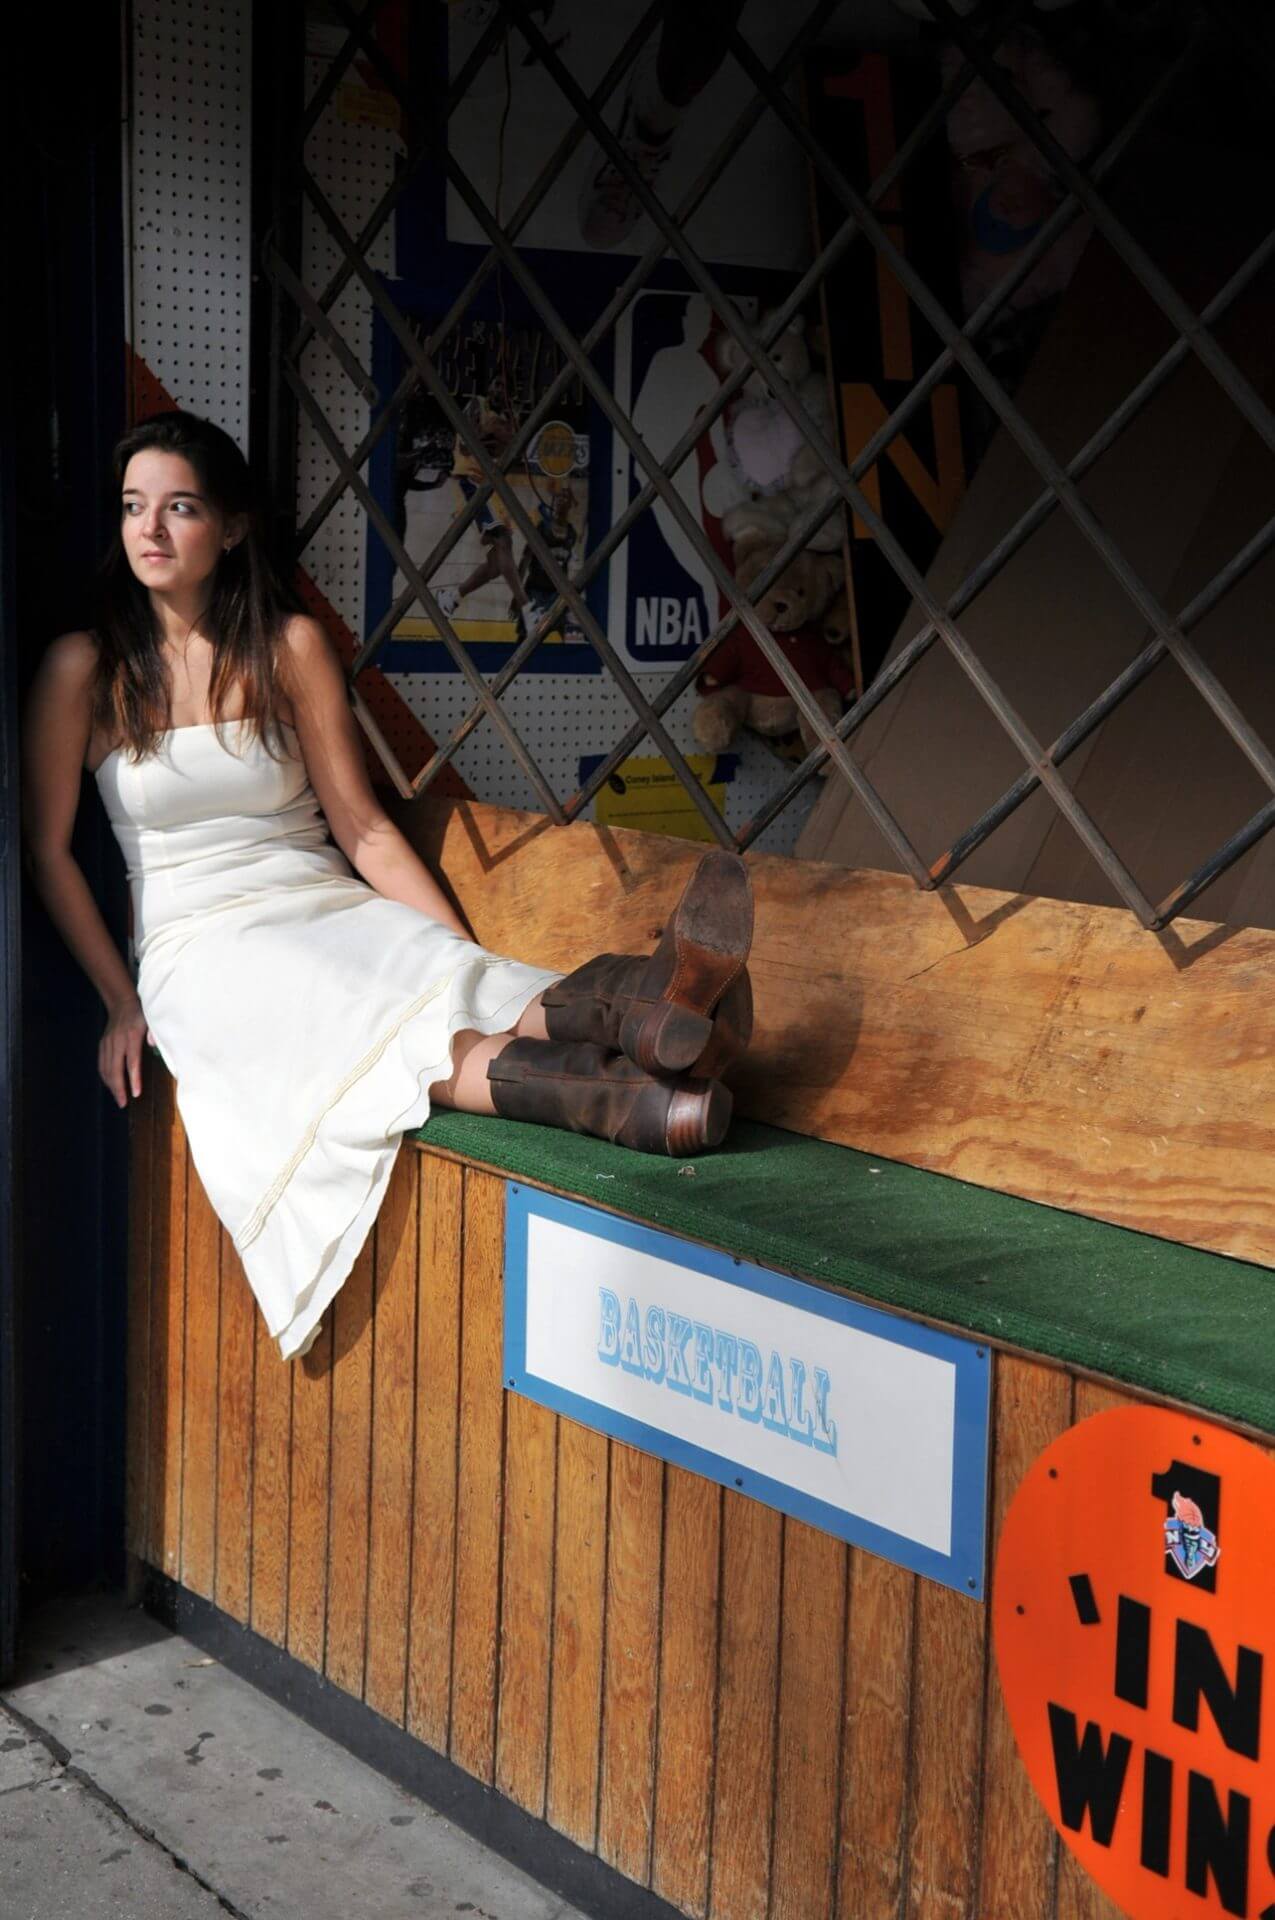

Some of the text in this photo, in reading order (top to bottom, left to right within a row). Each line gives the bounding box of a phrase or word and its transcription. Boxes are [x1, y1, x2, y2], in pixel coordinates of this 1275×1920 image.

[635, 597, 704, 646] NBA
[597, 1286, 838, 1458] BASKETBALL
[1151, 1459, 1221, 1595] 1
